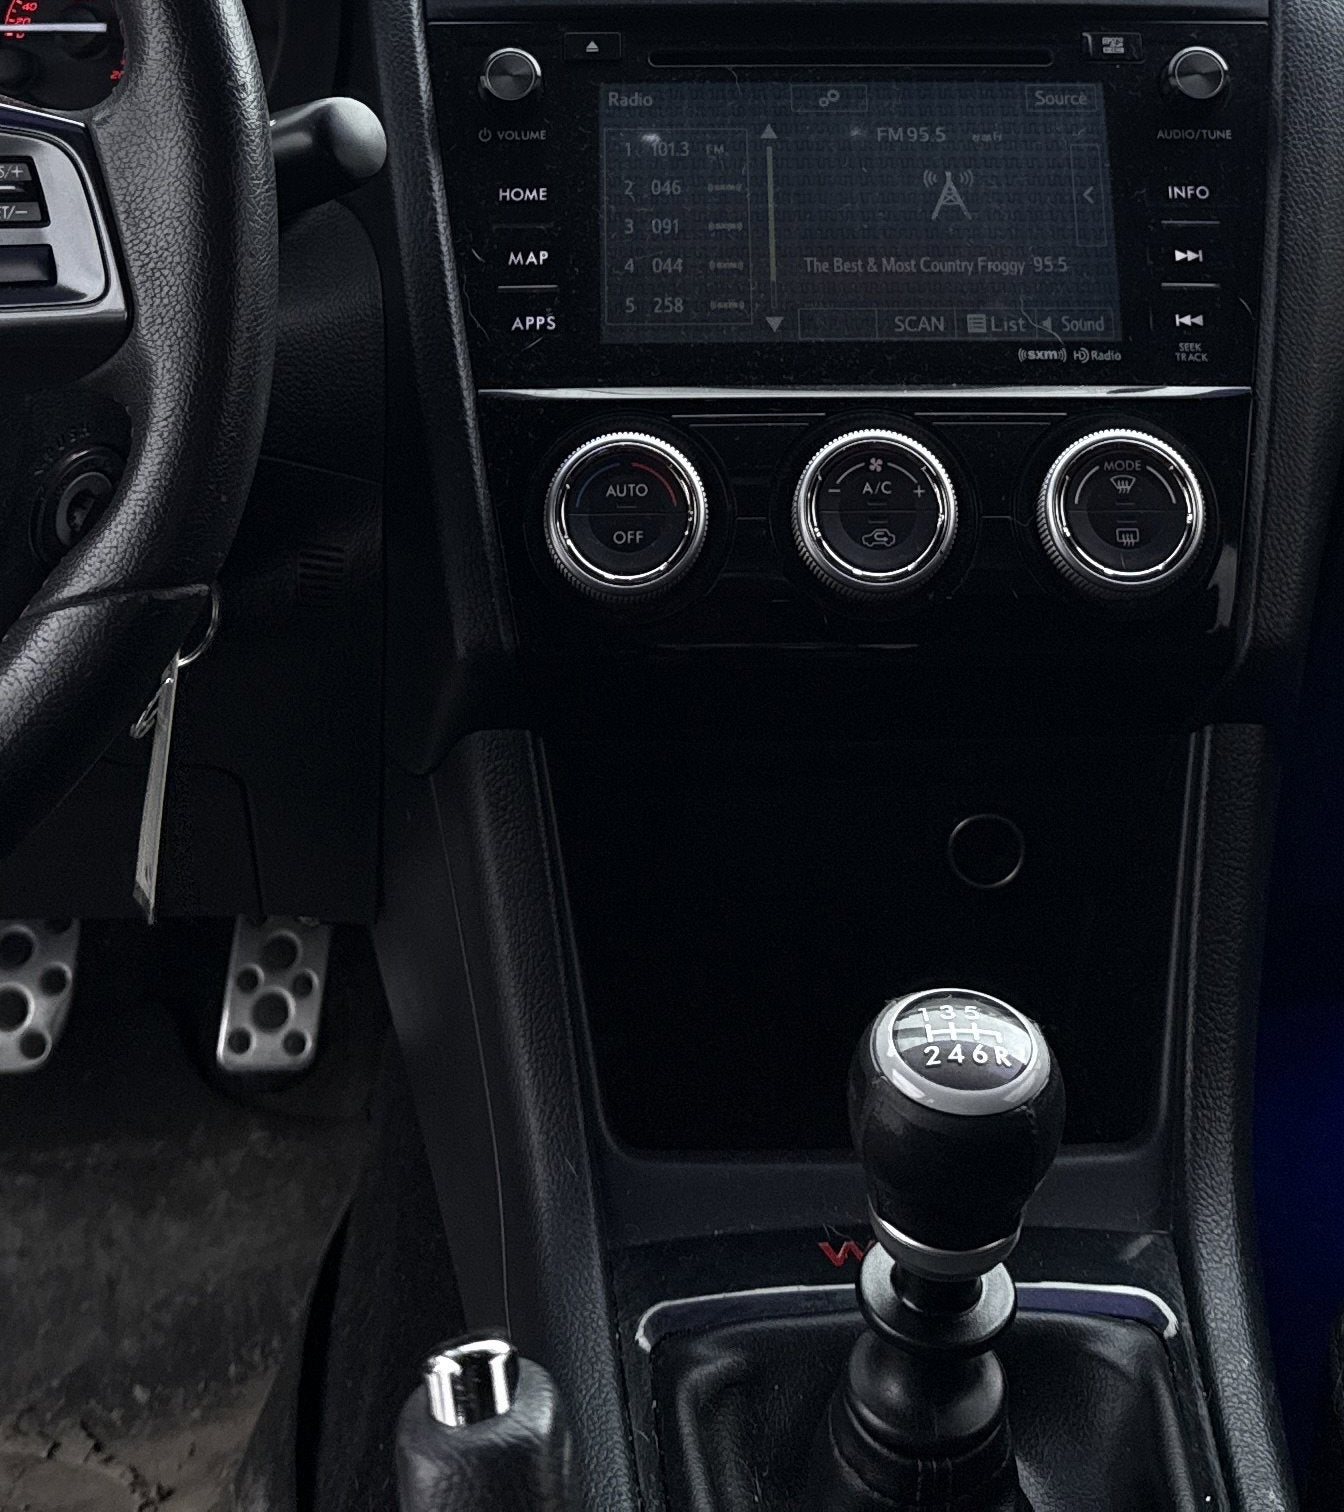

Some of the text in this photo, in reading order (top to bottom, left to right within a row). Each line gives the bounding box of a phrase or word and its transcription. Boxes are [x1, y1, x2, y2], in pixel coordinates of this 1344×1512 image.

[609, 92, 653, 107] Radio
[1035, 90, 1087, 106] Source
[497, 130, 547, 140] VOLUME
[1157, 129, 1232, 140] AUDIO/TUNE
[652, 142, 690, 157] 101.3
[498, 188, 548, 201] HOME
[624, 179, 681, 195] 2 046
[1168, 186, 1209, 199] INFO
[624, 218, 679, 234] 3 091
[508, 251, 549, 265] MAP
[624, 258, 683, 273] 4 044
[804, 257, 829, 273] The
[833, 257, 863, 273] Best
[866, 258, 878, 273] &
[882, 257, 916, 273] Most
[920, 257, 974, 275] Country
[978, 256, 1025, 276] Froggy
[625, 298, 684, 313] 5 258
[511, 316, 556, 331] APPS
[894, 316, 945, 332] SCAN
[991, 316, 1027, 332] List
[1061, 315, 1104, 332] Sound
[1091, 349, 1121, 361] Radio
[1178, 343, 1202, 352] SEEK
[1175, 353, 1208, 362] TRACK
[1104, 460, 1142, 471] MODE
[606, 483, 648, 497] AUTO
[862, 480, 893, 495] A/C
[613, 531, 644, 545] OFF
[918, 1005, 979, 1022] 1 3 5
[923, 1044, 1011, 1067] 2 4 6 R
